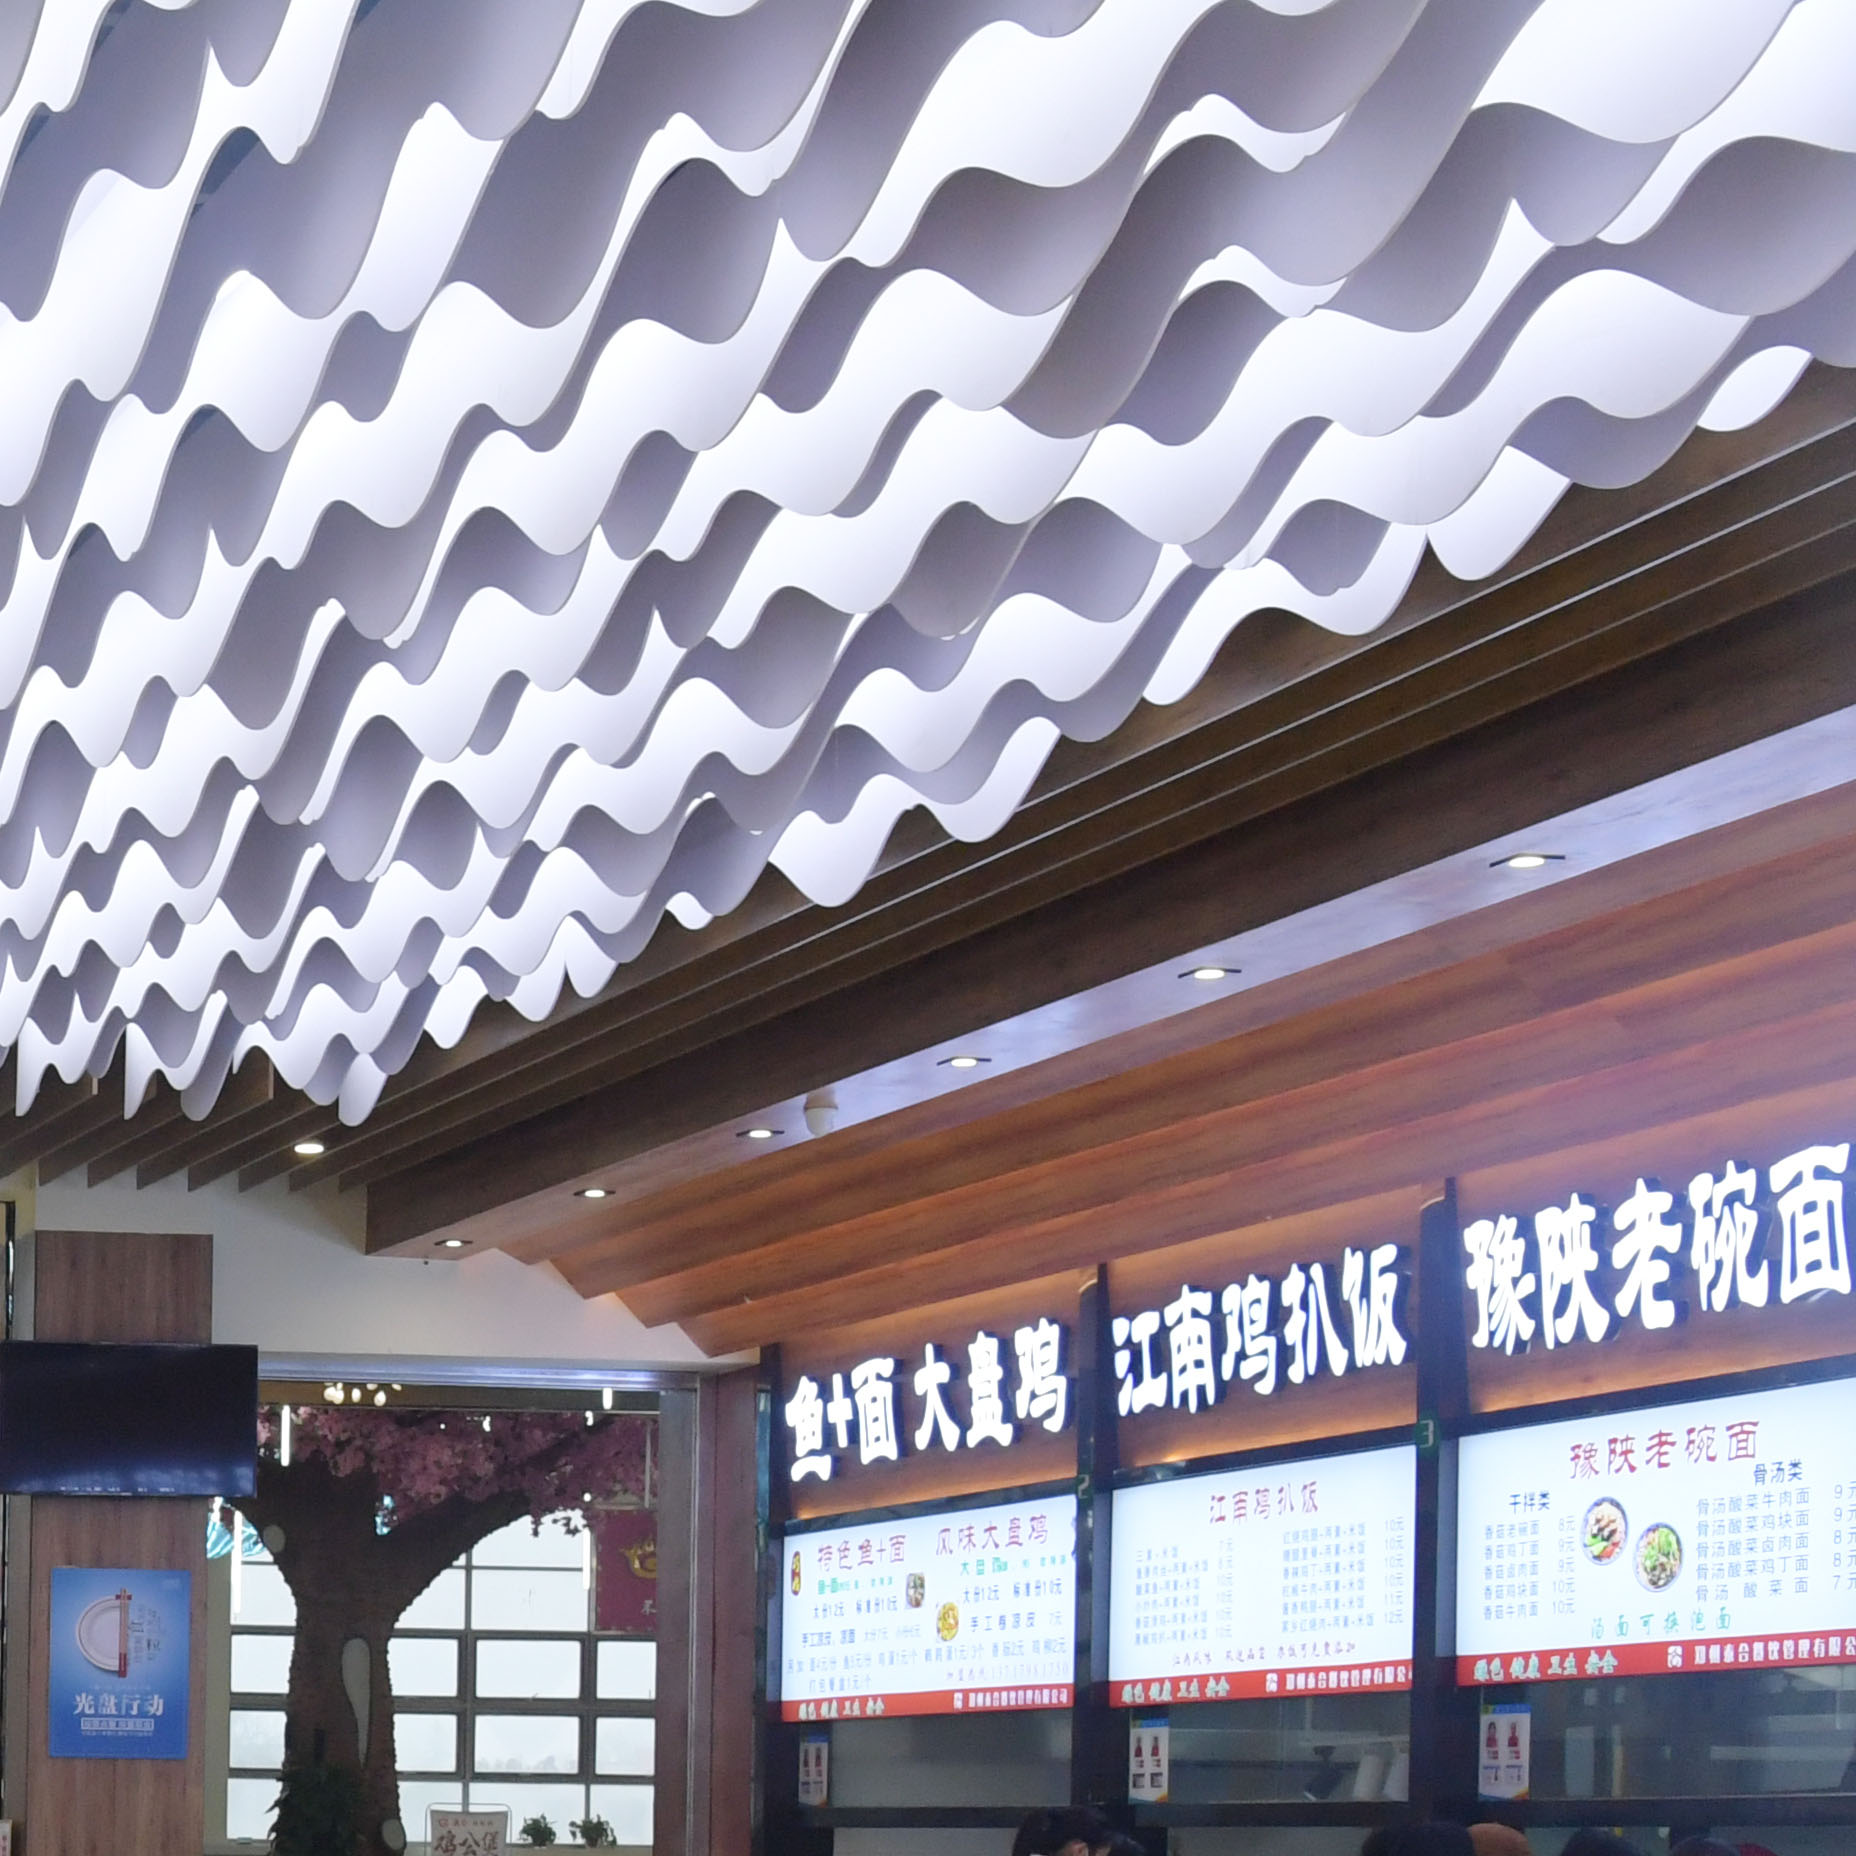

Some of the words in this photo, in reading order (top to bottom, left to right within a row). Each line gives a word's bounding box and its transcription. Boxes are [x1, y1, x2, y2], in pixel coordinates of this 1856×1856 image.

[1463, 1142, 1851, 1356] 豫陕老碗面
[1112, 1243, 1407, 1417] 江南鸡扒饭
[914, 1317, 1067, 1453] 大盘鸡
[1419, 1419, 1435, 1448] 3
[1570, 1421, 1759, 1479] 豫陕老碗面
[1754, 1459, 1803, 1485] 骨汤类
[1210, 1481, 1318, 1524] 江南鸡扒饭
[1509, 1491, 1551, 1514] 干拌类
[1697, 1487, 1810, 1517] 骨汤酸菜牛肉面
[936, 1514, 1048, 1556] 风味大盘鸡
[1696, 1509, 1810, 1538] 骨汤酸菜鸡块面
[1696, 1555, 1809, 1581] 骨汤酸菜鸡丁面
[1510, 1653, 1540, 1678] 健康
[1548, 1652, 1577, 1675] 卫生
[1585, 1650, 1618, 1674] 安全
[1177, 1677, 1200, 1698] 卫生
[1205, 1675, 1230, 1698] 安全
[73, 1692, 164, 1716] 光盘行动
